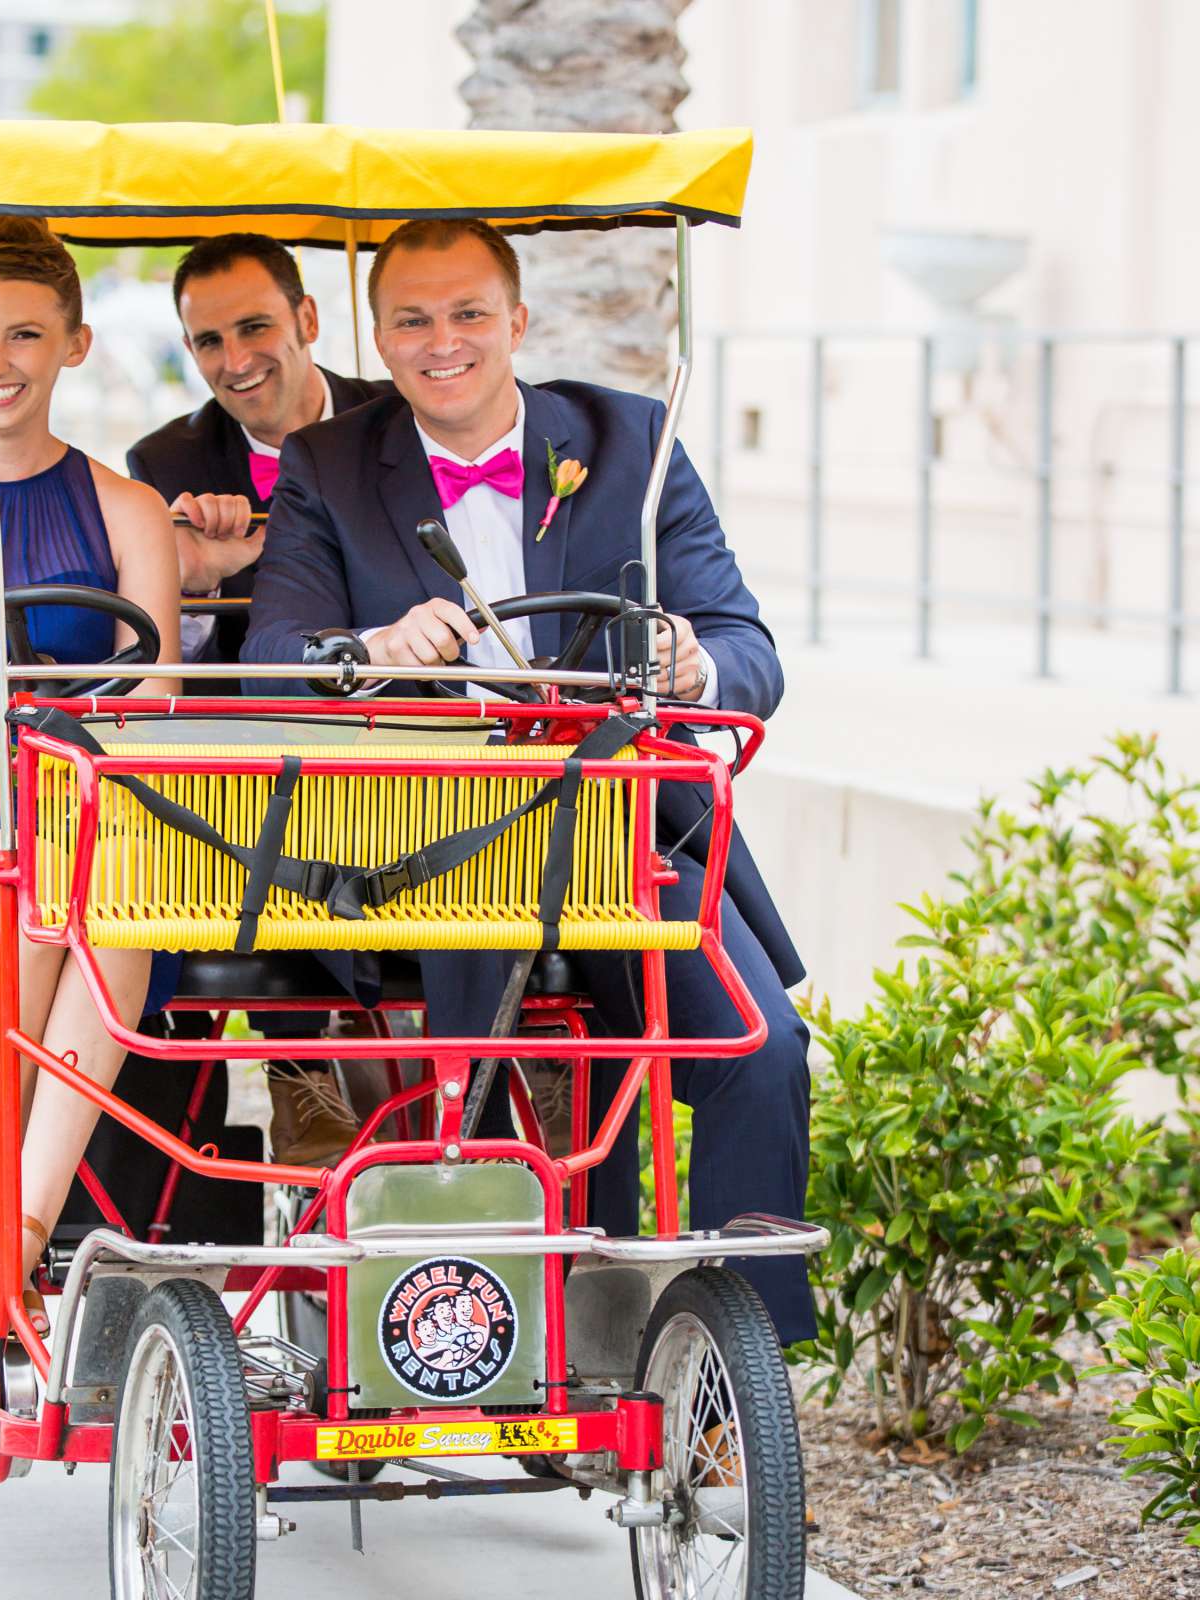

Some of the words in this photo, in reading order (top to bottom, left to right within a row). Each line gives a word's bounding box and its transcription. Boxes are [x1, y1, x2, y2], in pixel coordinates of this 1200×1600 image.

[389, 1266, 463, 1322] WHEEL
[467, 1272, 507, 1322] FUN
[390, 1338, 502, 1391] RENTALS
[334, 1426, 416, 1450] Double
[419, 1426, 492, 1450] Surrey
